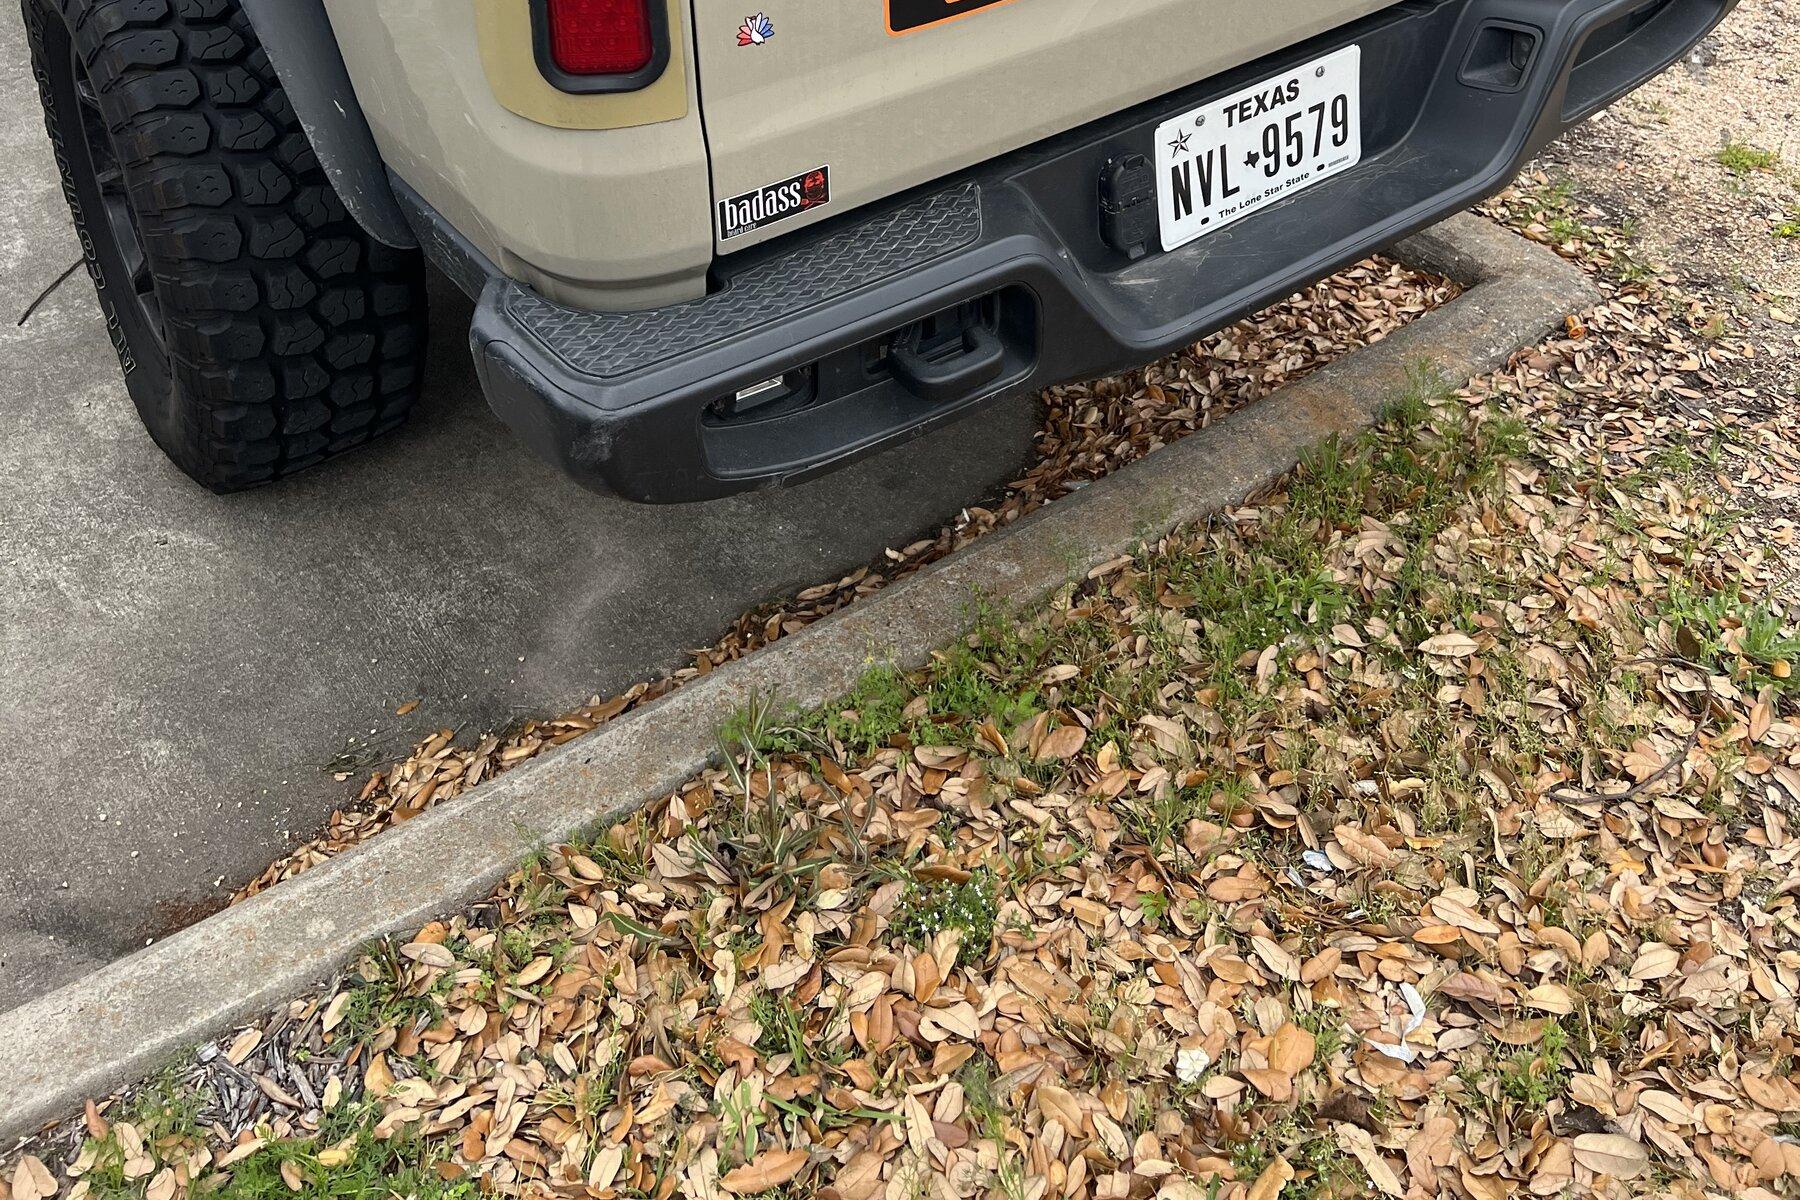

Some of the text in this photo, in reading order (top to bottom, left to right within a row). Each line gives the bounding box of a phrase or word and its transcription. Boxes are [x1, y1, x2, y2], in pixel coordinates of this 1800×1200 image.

[1223, 78, 1300, 128] TEXAS
[1171, 93, 1349, 221] NVL 9579
[724, 180, 801, 230] badass
[1218, 172, 1310, 218] The Lone Star State
[727, 221, 757, 238] beard care
[109, 301, 136, 375] ALL
